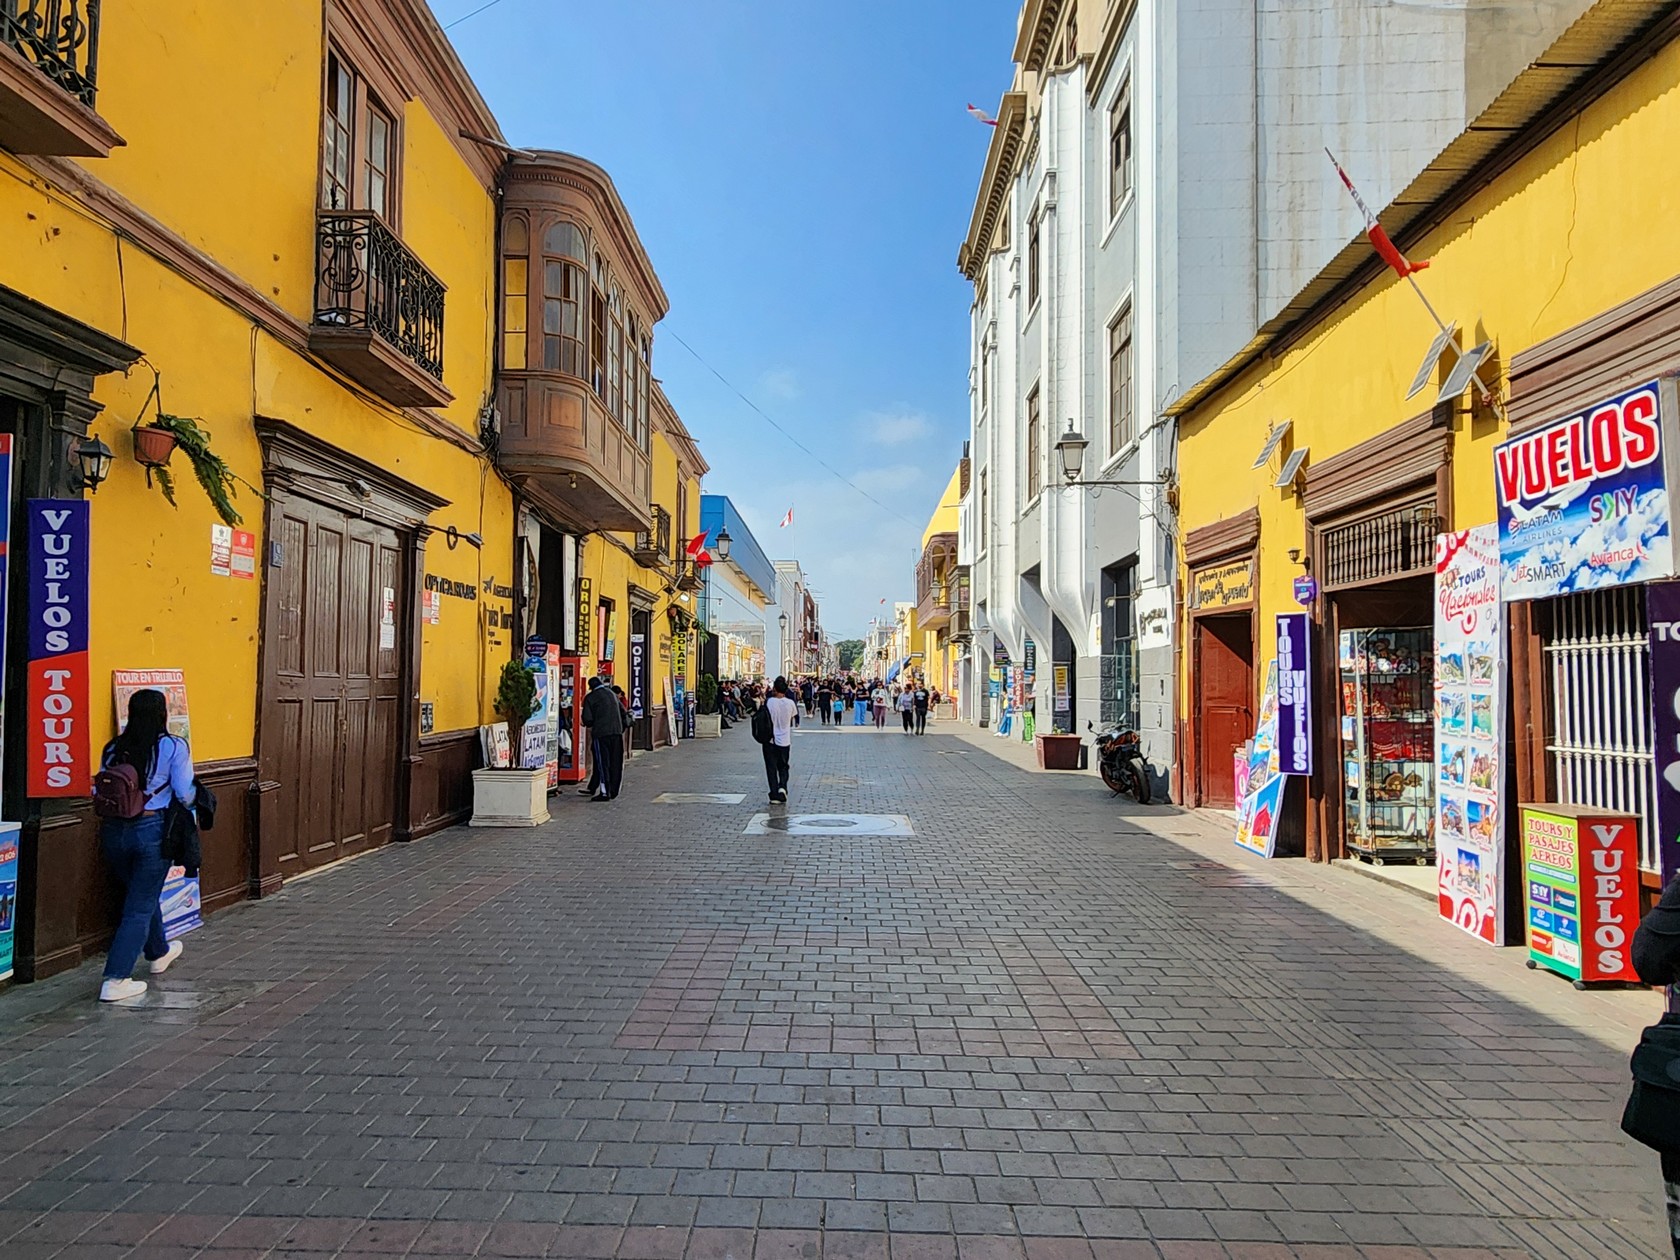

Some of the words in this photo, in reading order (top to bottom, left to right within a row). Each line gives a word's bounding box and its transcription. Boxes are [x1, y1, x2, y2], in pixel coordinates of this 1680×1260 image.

[1497, 392, 1659, 507] VUELOS
[1521, 510, 1564, 530] LATAM
[1523, 527, 1563, 544] AIRLINES
[1591, 548, 1635, 567] Avianca
[41, 508, 73, 652] VUELOS
[1459, 566, 1486, 588] TOURS
[580, 579, 590, 614] ORO
[1440, 578, 1496, 621] Nacionales
[1278, 618, 1293, 706] TOURS
[116, 672, 140, 684] TOUR
[141, 672, 151, 683] EN
[152, 672, 183, 683] TRUJILLO
[632, 645, 642, 708] OPTICA
[43, 670, 74, 788] TOURS
[1292, 670, 1307, 772] VUELOS
[495, 730, 509, 744] LATA
[525, 736, 546, 752] LATAM
[1529, 818, 1563, 837] TOURS
[1564, 826, 1574, 839] Y
[1529, 834, 1574, 854] PASAJES
[1531, 849, 1573, 869] AEREOS
[1590, 824, 1625, 974] VUELOS
